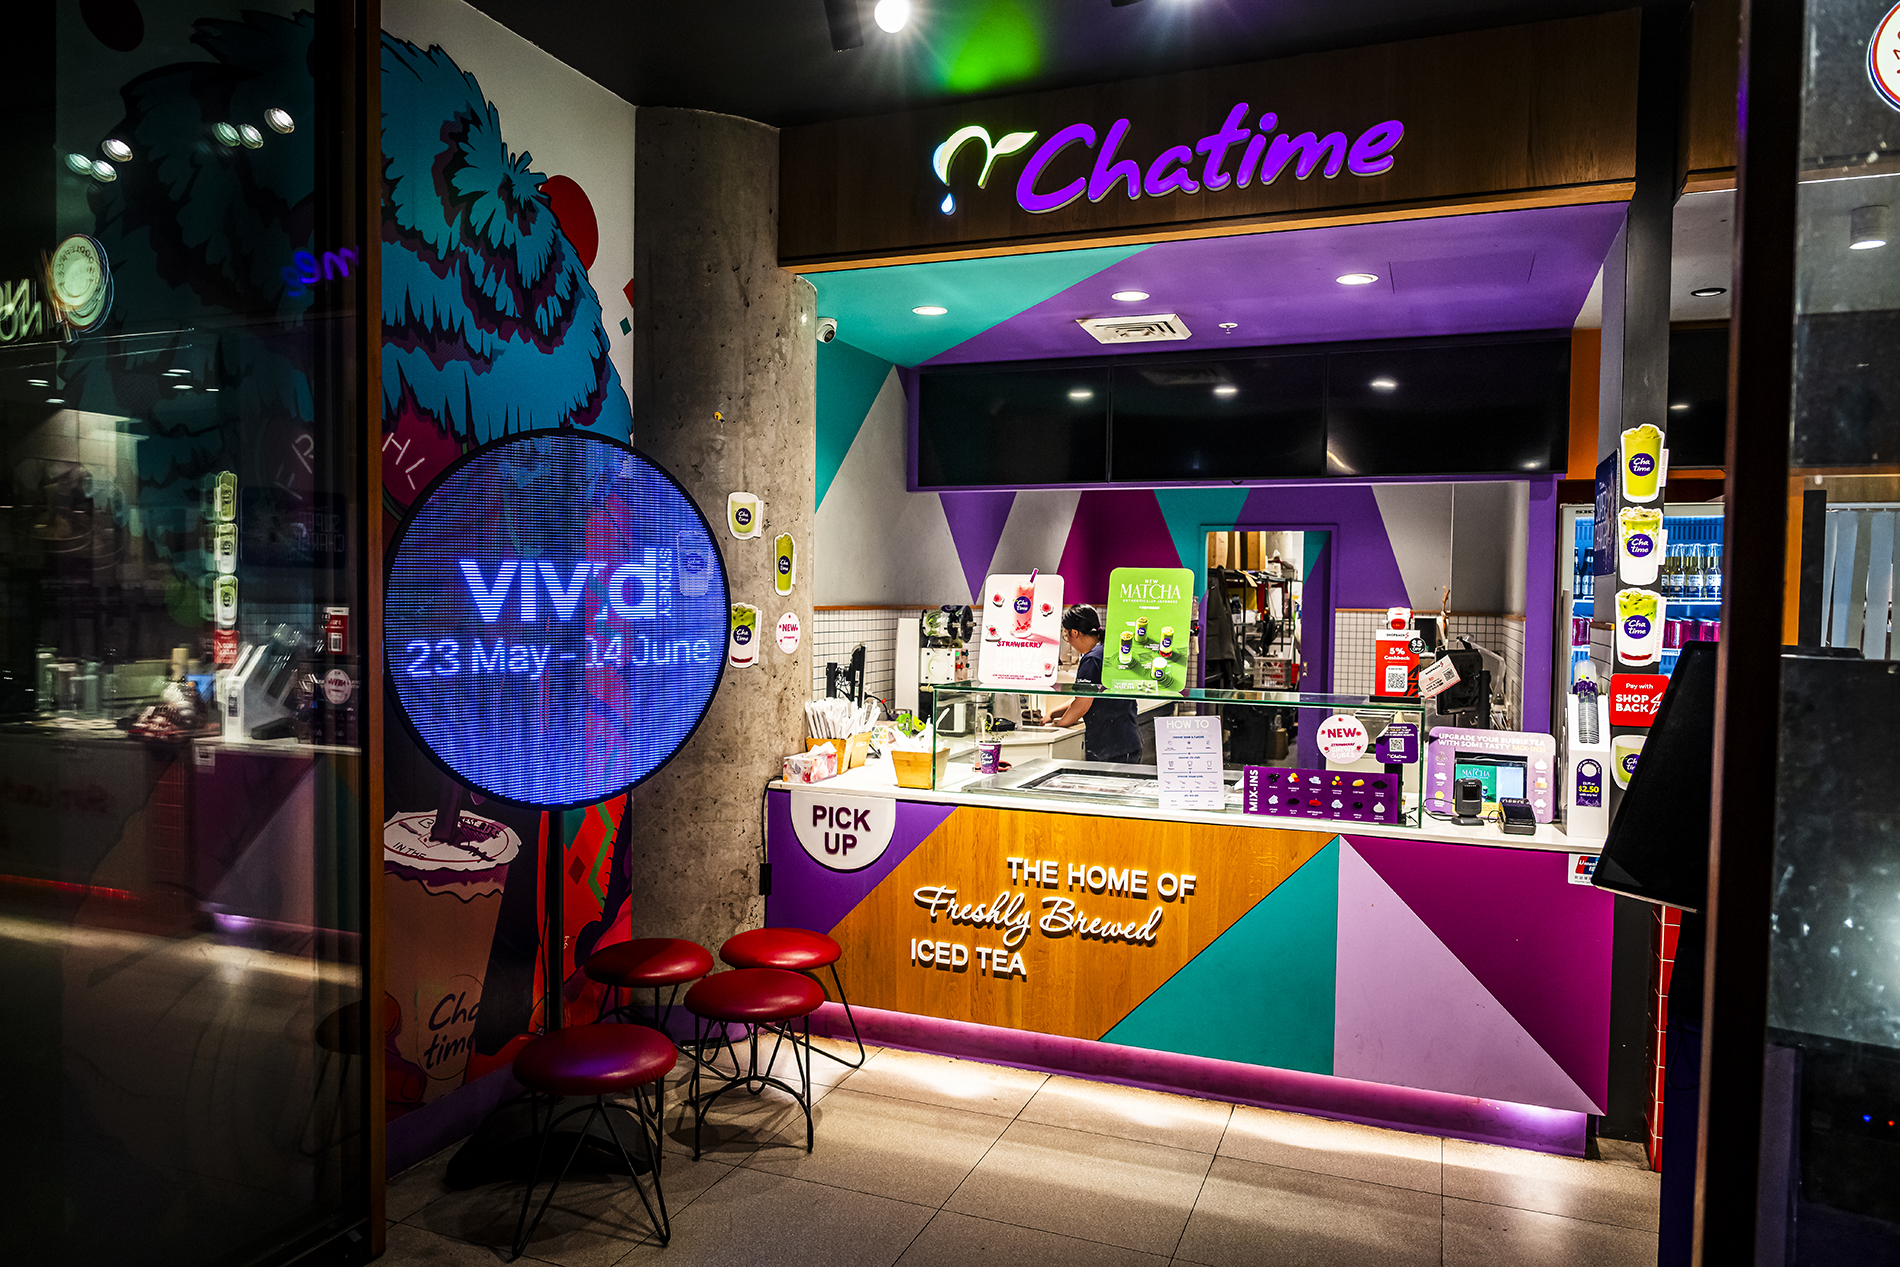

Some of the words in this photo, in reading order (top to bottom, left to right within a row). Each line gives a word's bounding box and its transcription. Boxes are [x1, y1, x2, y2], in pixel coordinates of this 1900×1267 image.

[1016, 102, 1405, 214] Chatime
[1631, 538, 1649, 546] Cha
[659, 548, 673, 619] SYDNEY
[1120, 583, 1181, 600] MATCHA
[782, 623, 797, 632] NEW
[1628, 620, 1646, 628] Cha
[1389, 647, 1405, 655] 5%
[406, 639, 461, 677] 23
[471, 637, 550, 681] May
[585, 635, 622, 668] 14
[632, 635, 711, 666] June
[1615, 694, 1649, 703] SHOP
[1615, 703, 1649, 713] BACK
[1166, 720, 1191, 729] HOW
[1194, 719, 1209, 729] TO
[1327, 728, 1357, 738] NEW
[1439, 733, 1475, 741] UPGRADE
[1477, 735, 1500, 743] YOUR
[1501, 737, 1527, 745] BUBBLE
[1438, 739, 1460, 747] WITH
[1484, 743, 1511, 751] TASTY
[1626, 757, 1638, 765] Ch
[1462, 769, 1490, 778] MATCHA
[1249, 769, 1259, 812] MIX-INS
[1578, 785, 1600, 794] $2.50
[812, 804, 872, 834] PICK
[824, 831, 858, 856] UP
[393, 842, 405, 852] IN
[405, 848, 427, 859] THE
[1007, 857, 1059, 885] THE
[1067, 863, 1149, 894] HOME
[1157, 873, 1197, 898] OF
[913, 886, 1031, 947] Freshly
[1039, 896, 1163, 942] Brewed
[910, 938, 969, 966] ICED
[976, 947, 1027, 976] TEA
